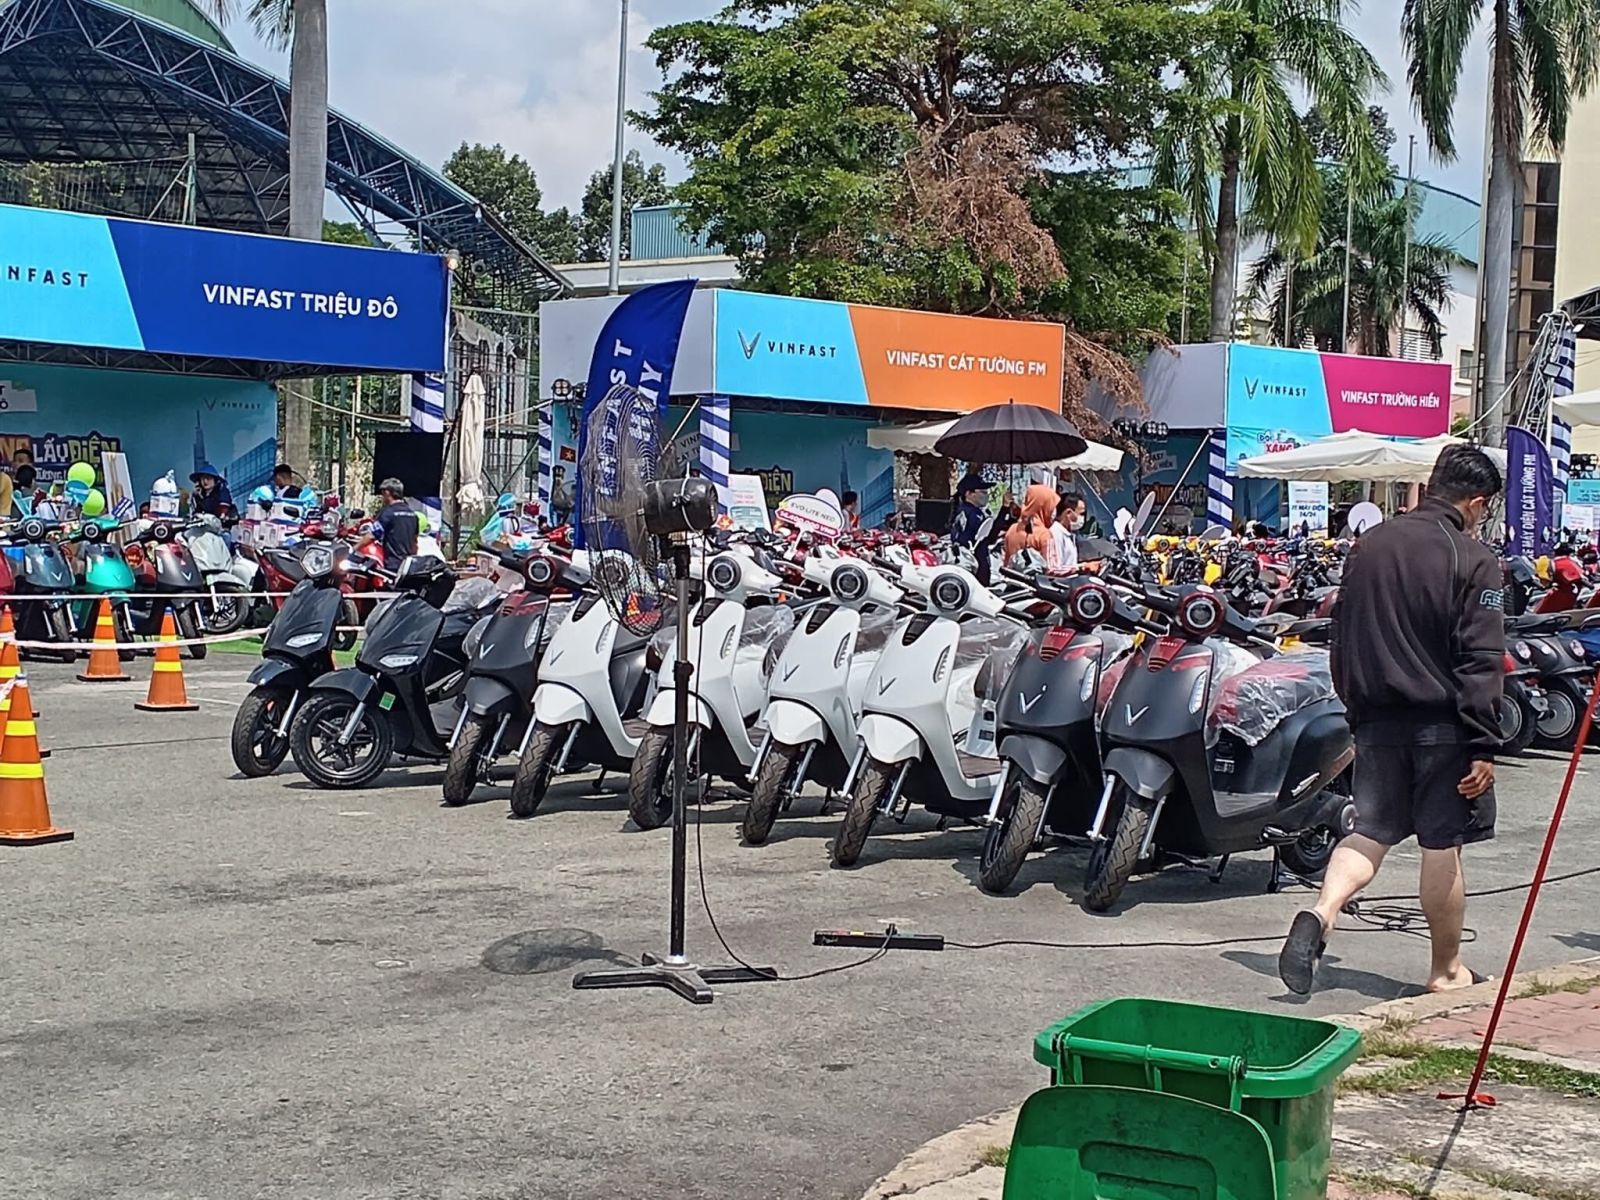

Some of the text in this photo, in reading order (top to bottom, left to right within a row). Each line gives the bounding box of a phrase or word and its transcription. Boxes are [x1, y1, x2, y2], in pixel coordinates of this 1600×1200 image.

[8, 265, 88, 288] NFAST
[203, 283, 399, 319] VINFAST TRIỆU ĐÔ
[768, 340, 837, 358] VINFAST
[886, 350, 1047, 376] VINFAST CÁT TƯỜNG FM
[1263, 384, 1307, 397] VINFAST
[1341, 390, 1380, 405] VINFAST
[1380, 391, 1418, 407] TRƯỜNG
[33, 438, 69, 463] LẤY
[1523, 454, 1536, 465] FM
[1520, 494, 1536, 510] CÁT
[1520, 511, 1537, 530] ĐIỆN
[1520, 532, 1536, 548] MÁY
